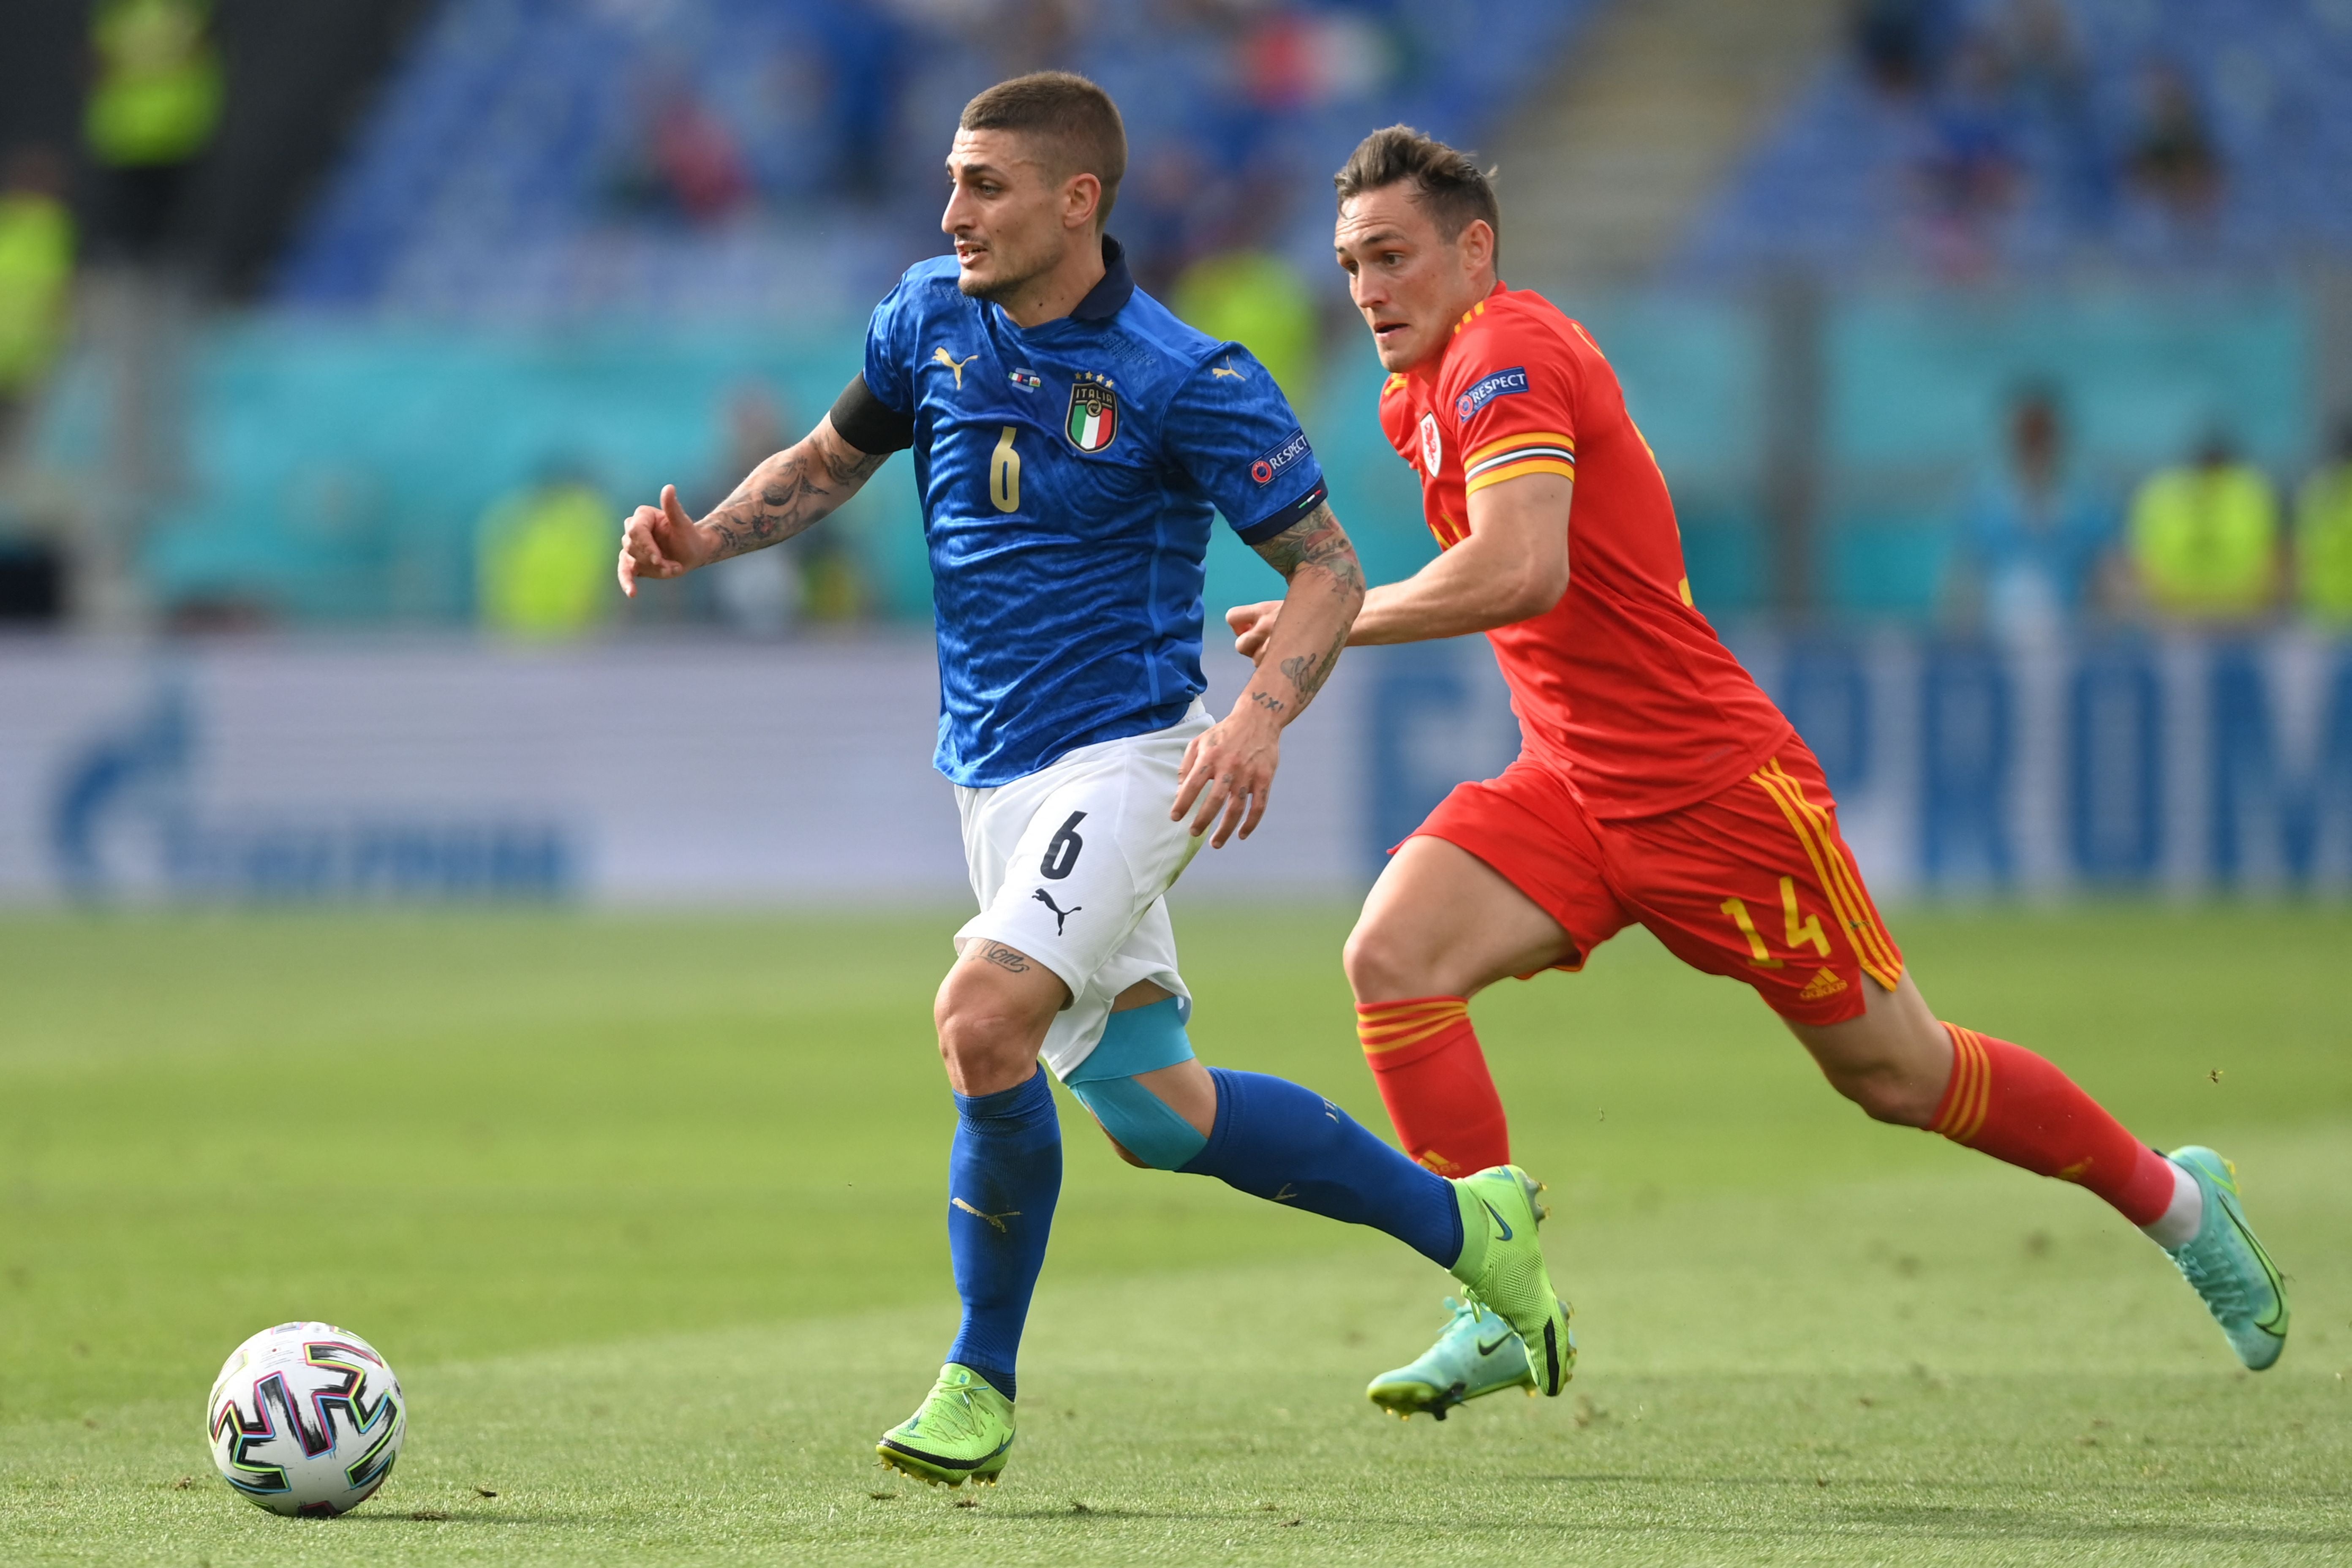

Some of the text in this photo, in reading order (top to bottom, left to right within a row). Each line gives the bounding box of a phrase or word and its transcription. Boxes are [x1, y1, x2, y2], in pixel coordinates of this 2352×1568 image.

[1076, 388, 1113, 403] ITALIA
[1472, 373, 1525, 403] RESPECT
[990, 426, 1021, 512] 6
[1269, 434, 1307, 470] RESPECT
[1040, 810, 1088, 879] 6
[1720, 875, 1831, 968] 14
